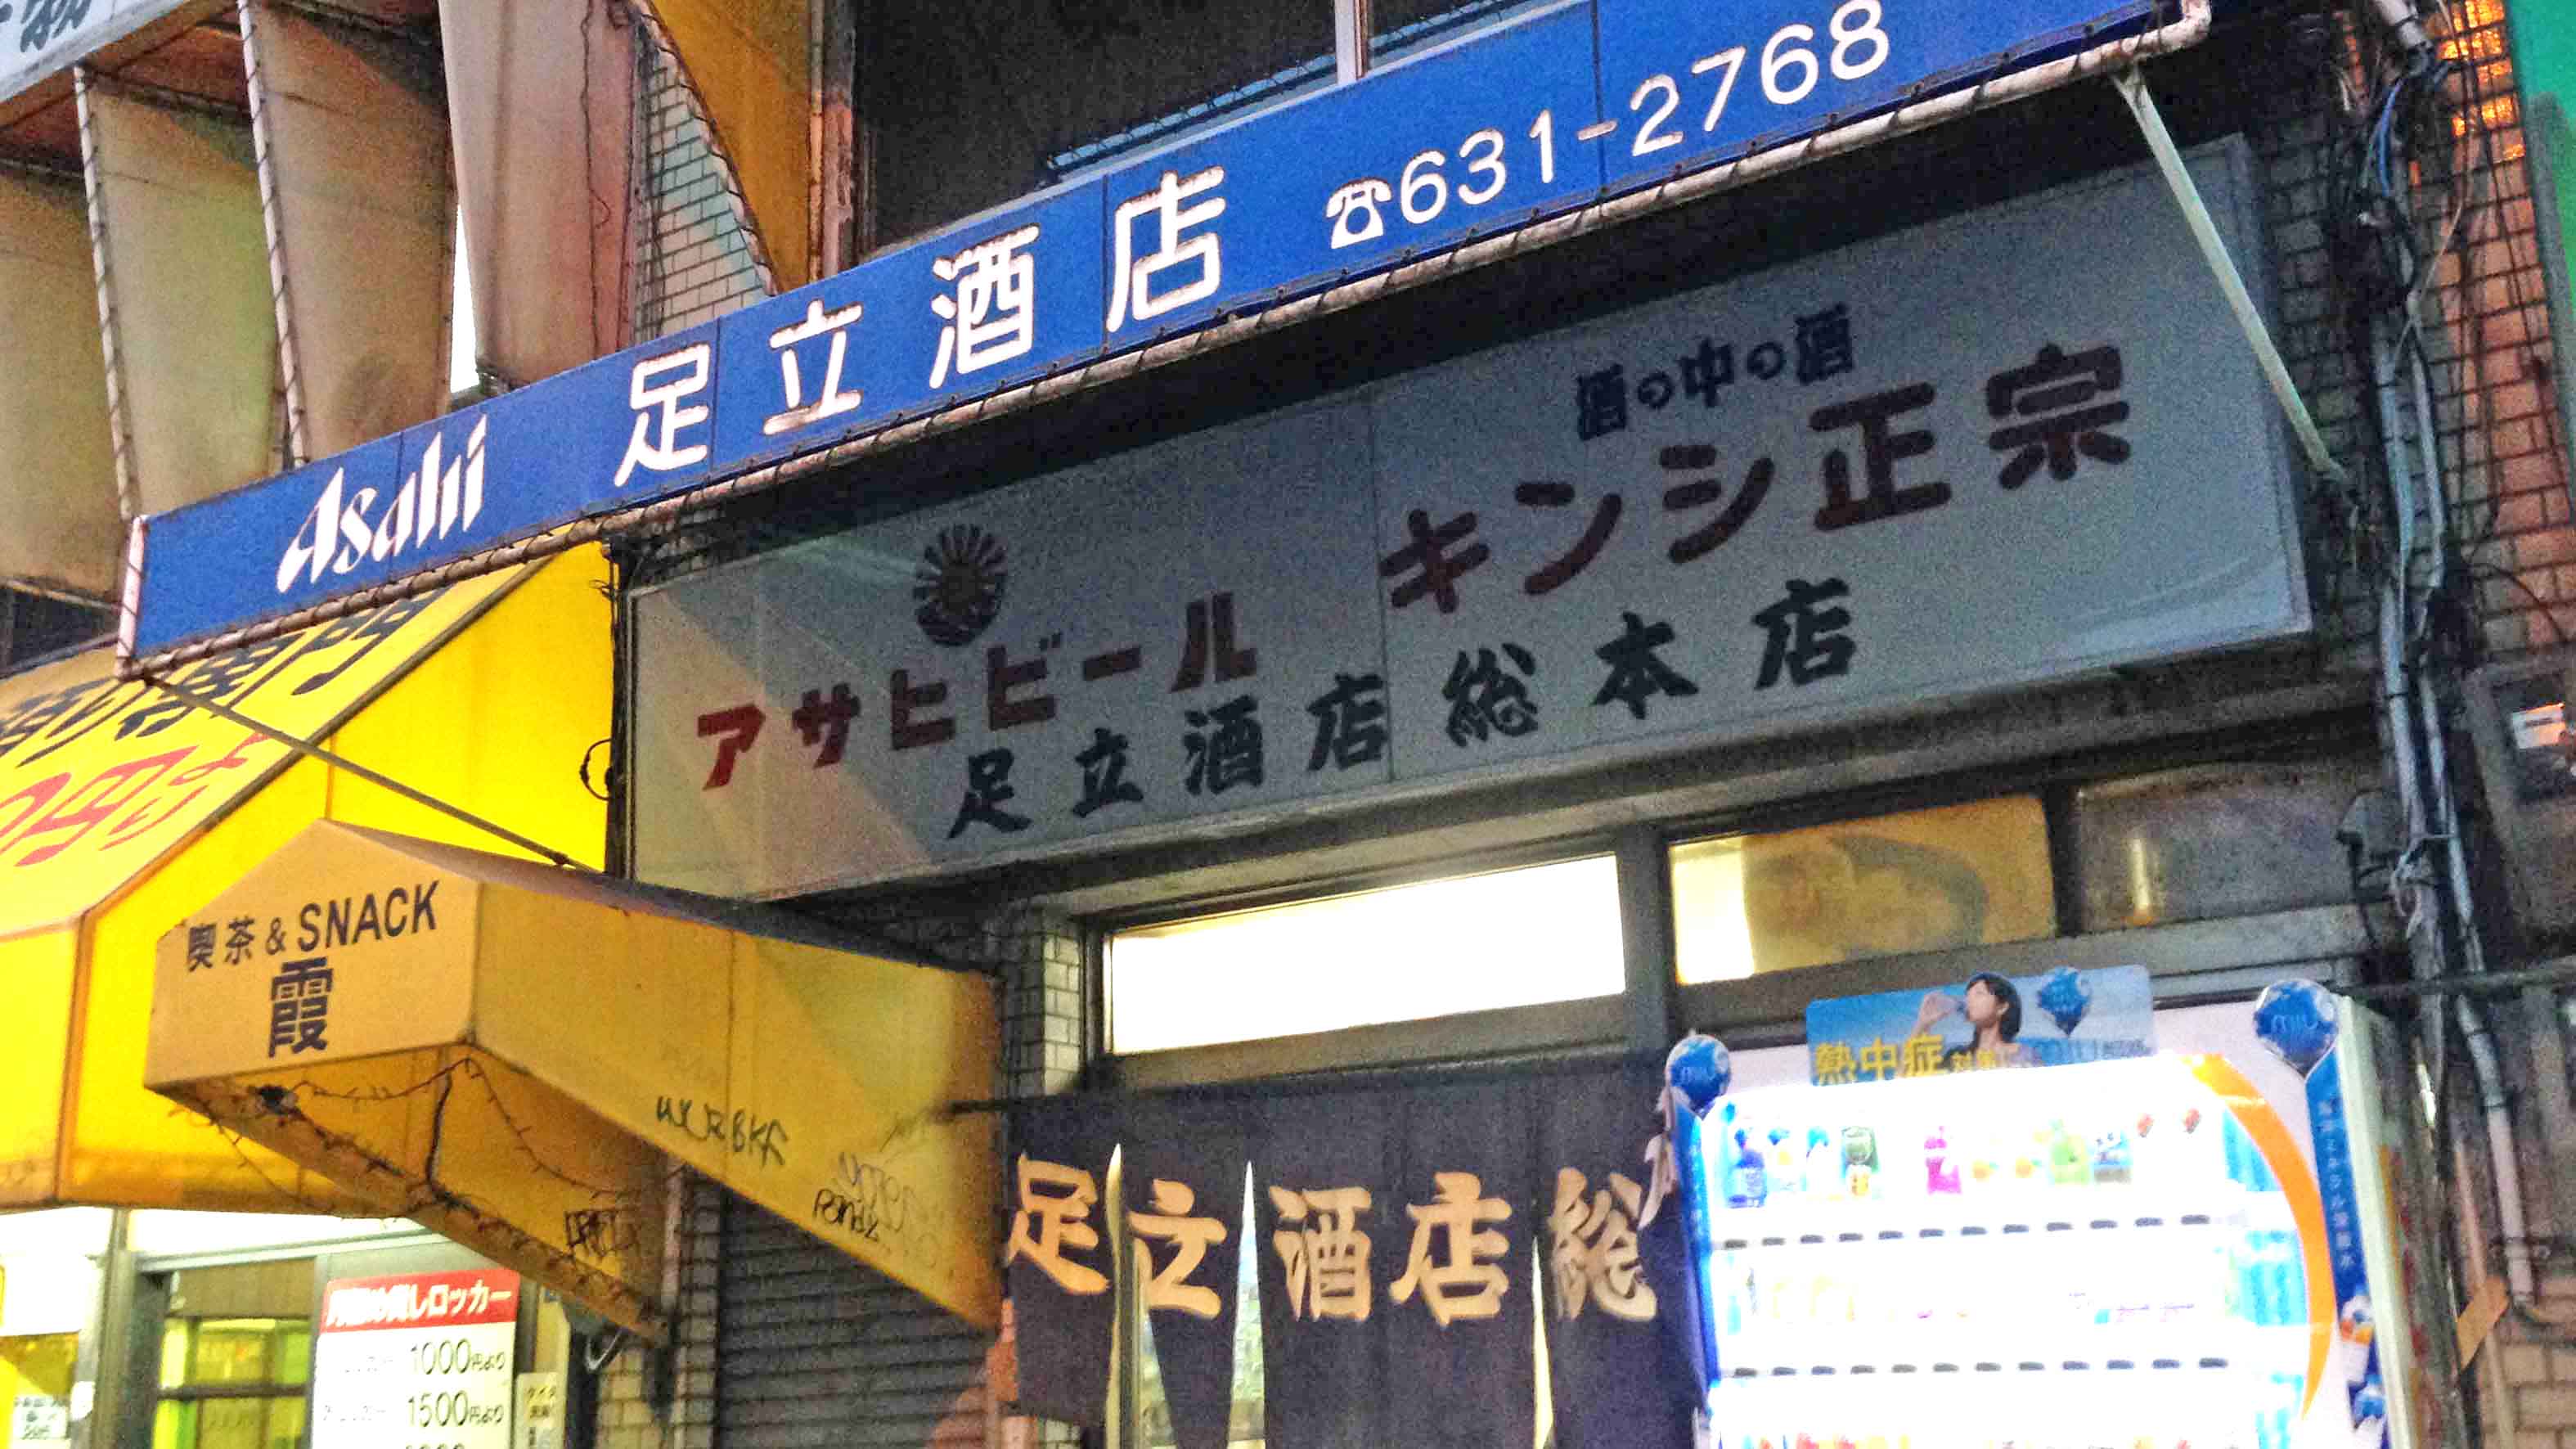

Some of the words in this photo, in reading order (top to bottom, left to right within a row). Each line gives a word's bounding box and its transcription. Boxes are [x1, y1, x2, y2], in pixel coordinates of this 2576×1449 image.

[276, 413, 487, 594] Asahi
[614, 165, 1225, 488] 足立酒店
[1400, 0, 1890, 224] 631-2768
[1576, 303, 1854, 442] 酒の中の酒
[1379, 342, 2131, 614] キンシ正宗
[697, 591, 1257, 791] アサヒビール
[949, 577, 1858, 839] 足立酒店総本店
[188, 916, 256, 973] 喫茶
[297, 880, 439, 952] SNACK
[267, 956, 334, 1059] 霞
